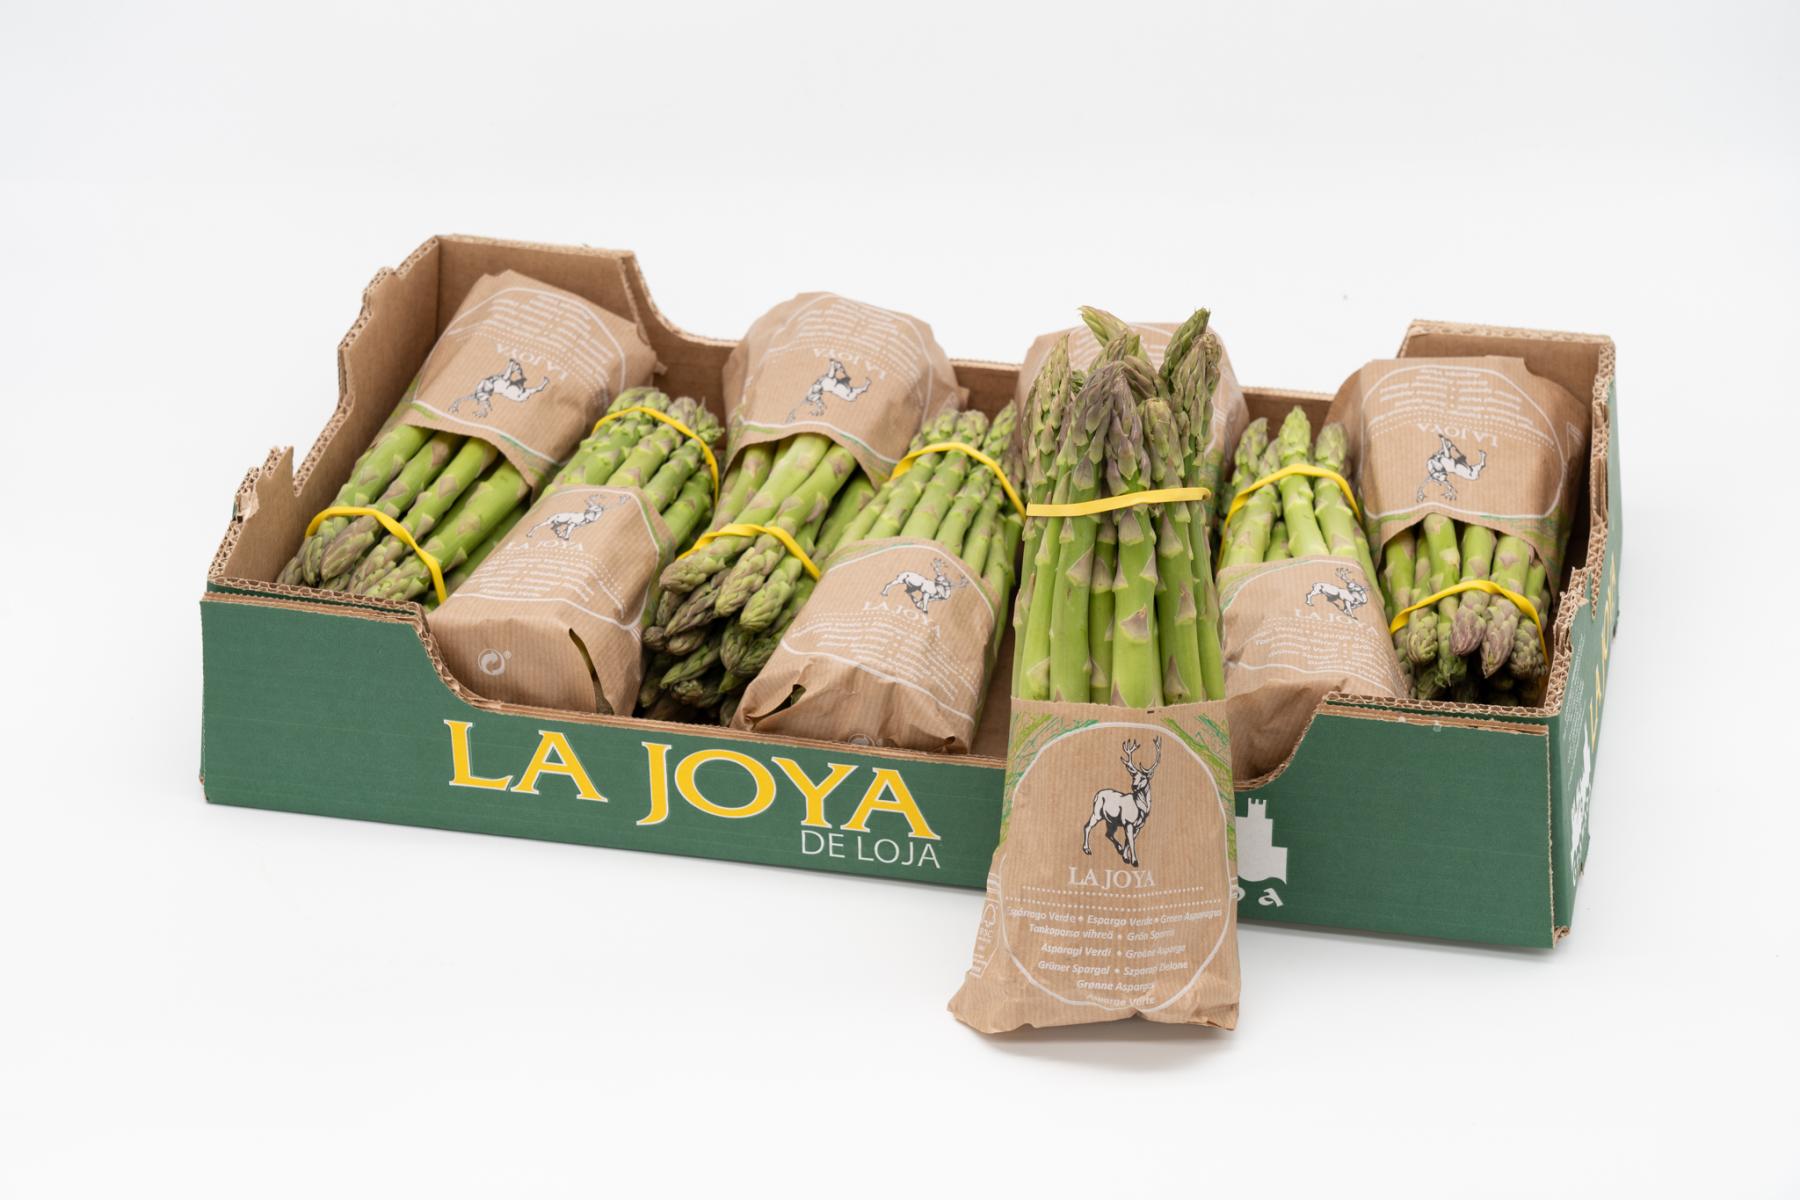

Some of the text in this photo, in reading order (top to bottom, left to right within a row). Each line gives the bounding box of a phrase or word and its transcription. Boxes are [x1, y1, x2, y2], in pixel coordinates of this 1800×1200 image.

[1416, 422, 1499, 448] LA JOYA
[443, 719, 942, 841] LA JOYA
[801, 830, 942, 869] DE LOJA
[1068, 866, 1157, 890] LA JOYA
[1087, 914, 1127, 928] Espargo
[1041, 942, 1083, 957] Asparagi
[1085, 946, 1112, 958] Verdi
[1037, 960, 1070, 974] Grüner
[1071, 963, 1112, 977] Spargel
